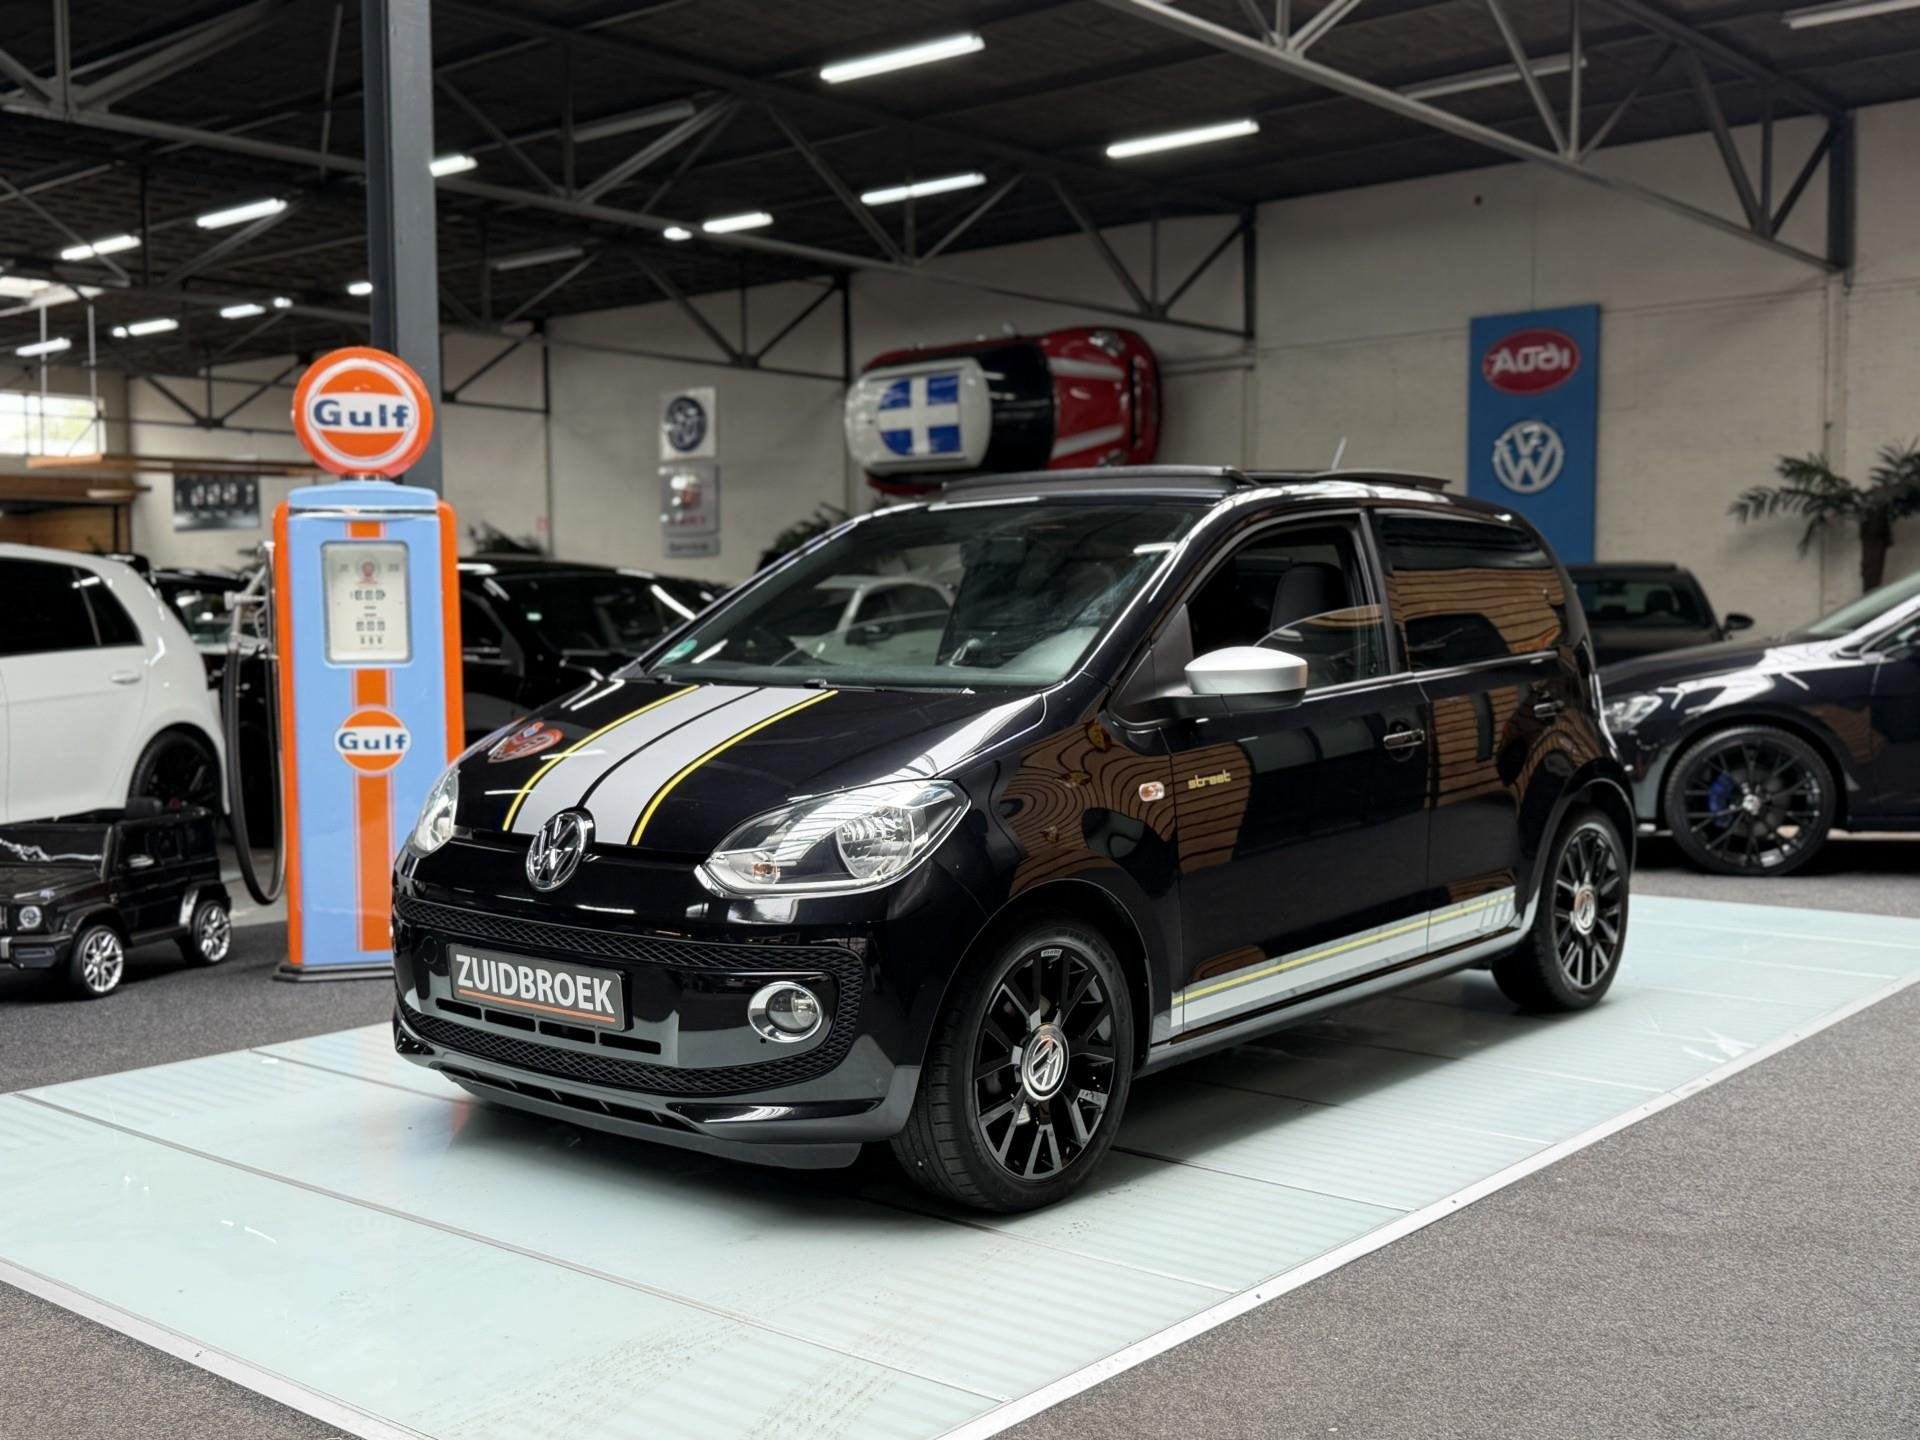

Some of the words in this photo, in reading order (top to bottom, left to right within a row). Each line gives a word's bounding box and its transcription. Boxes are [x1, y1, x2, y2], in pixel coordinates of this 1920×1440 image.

[313, 399, 409, 428] Gulf
[338, 731, 407, 750] Gulf
[1188, 769, 1231, 790] street
[455, 953, 616, 1014] ZUIDBROEK
